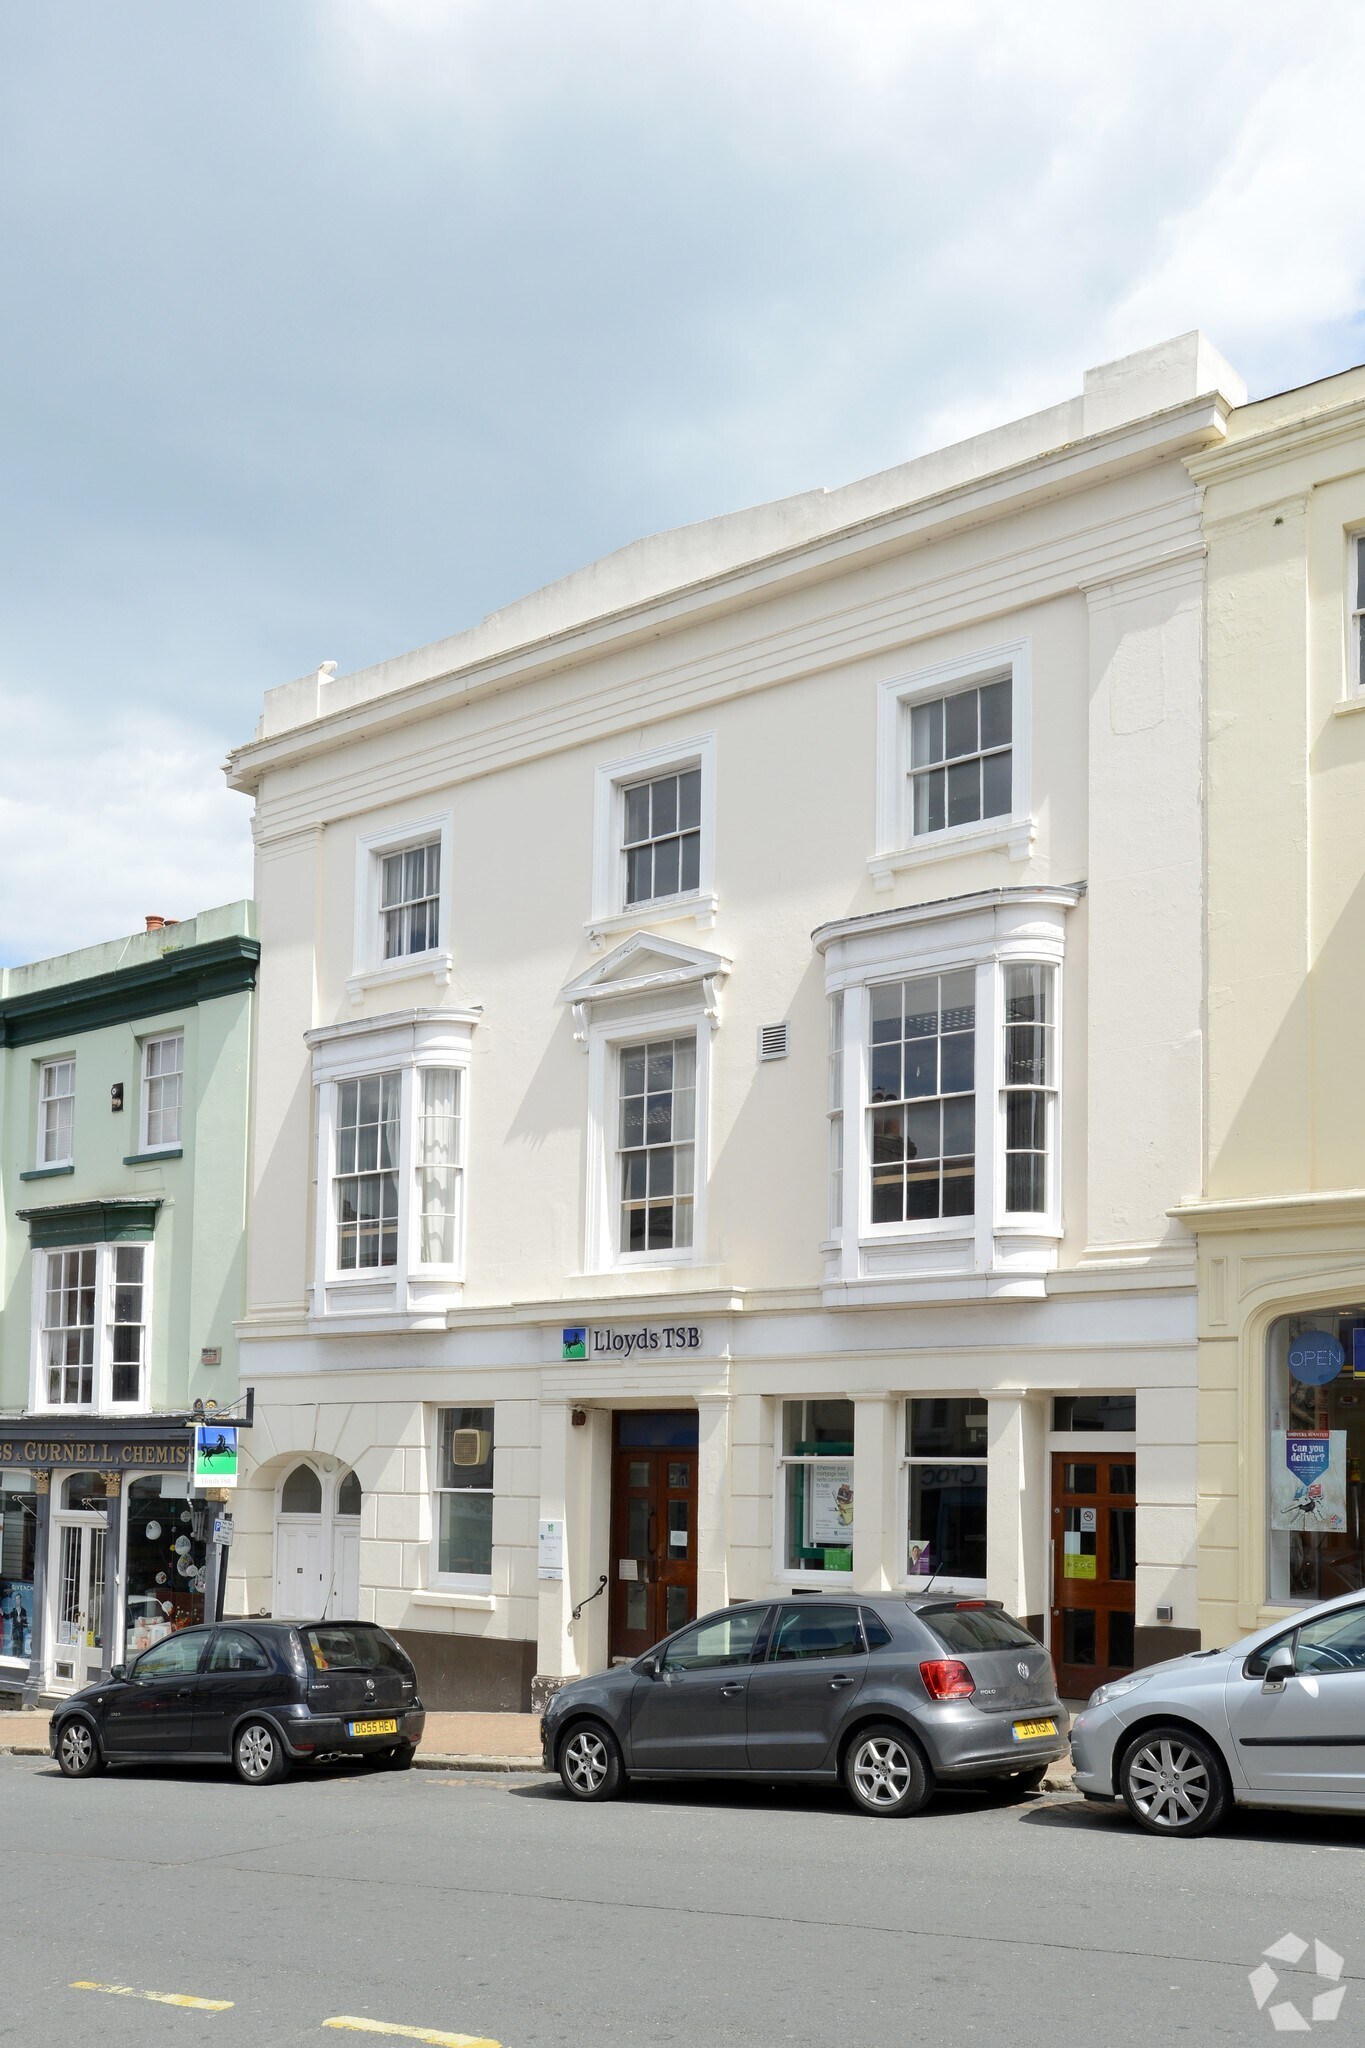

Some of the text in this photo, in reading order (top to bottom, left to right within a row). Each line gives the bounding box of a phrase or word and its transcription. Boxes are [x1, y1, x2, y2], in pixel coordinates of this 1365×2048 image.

[594, 1327, 700, 1357] Lloyds TSB
[1290, 1350, 1341, 1366] OPEN
[1292, 1444, 1324, 1453] Can you
[1291, 1453, 1325, 1462] deliver?
[355, 1721, 394, 1734] DG55 HEV
